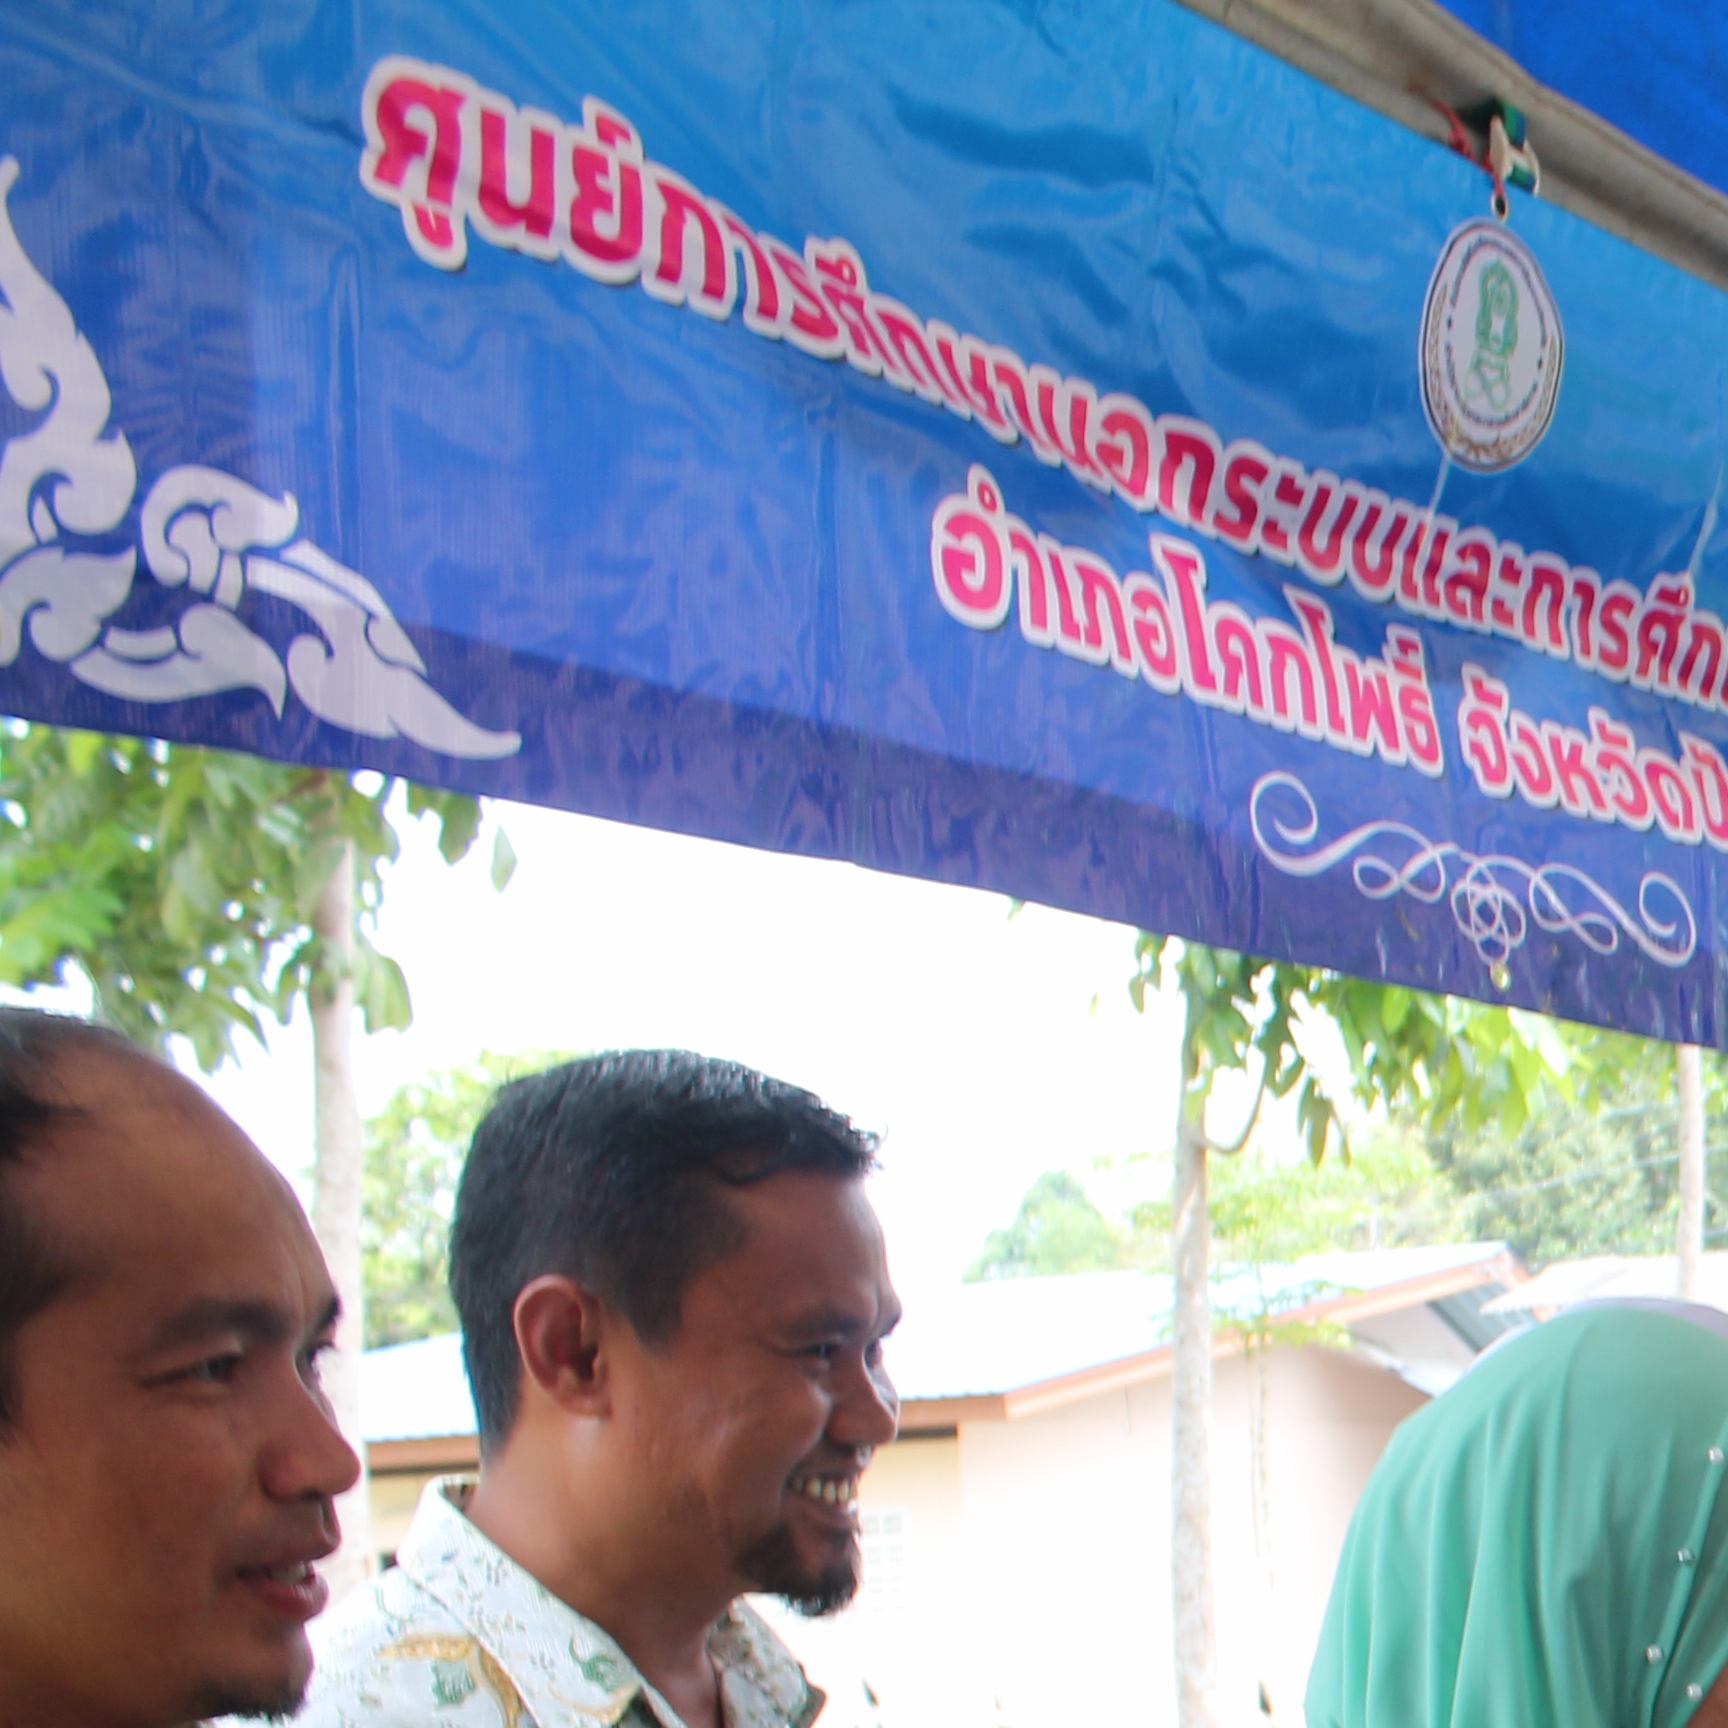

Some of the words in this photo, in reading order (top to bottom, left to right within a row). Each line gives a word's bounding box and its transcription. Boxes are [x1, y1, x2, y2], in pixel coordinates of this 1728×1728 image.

[932, 464, 1443, 776] อำเภอโคกโพธิ์
